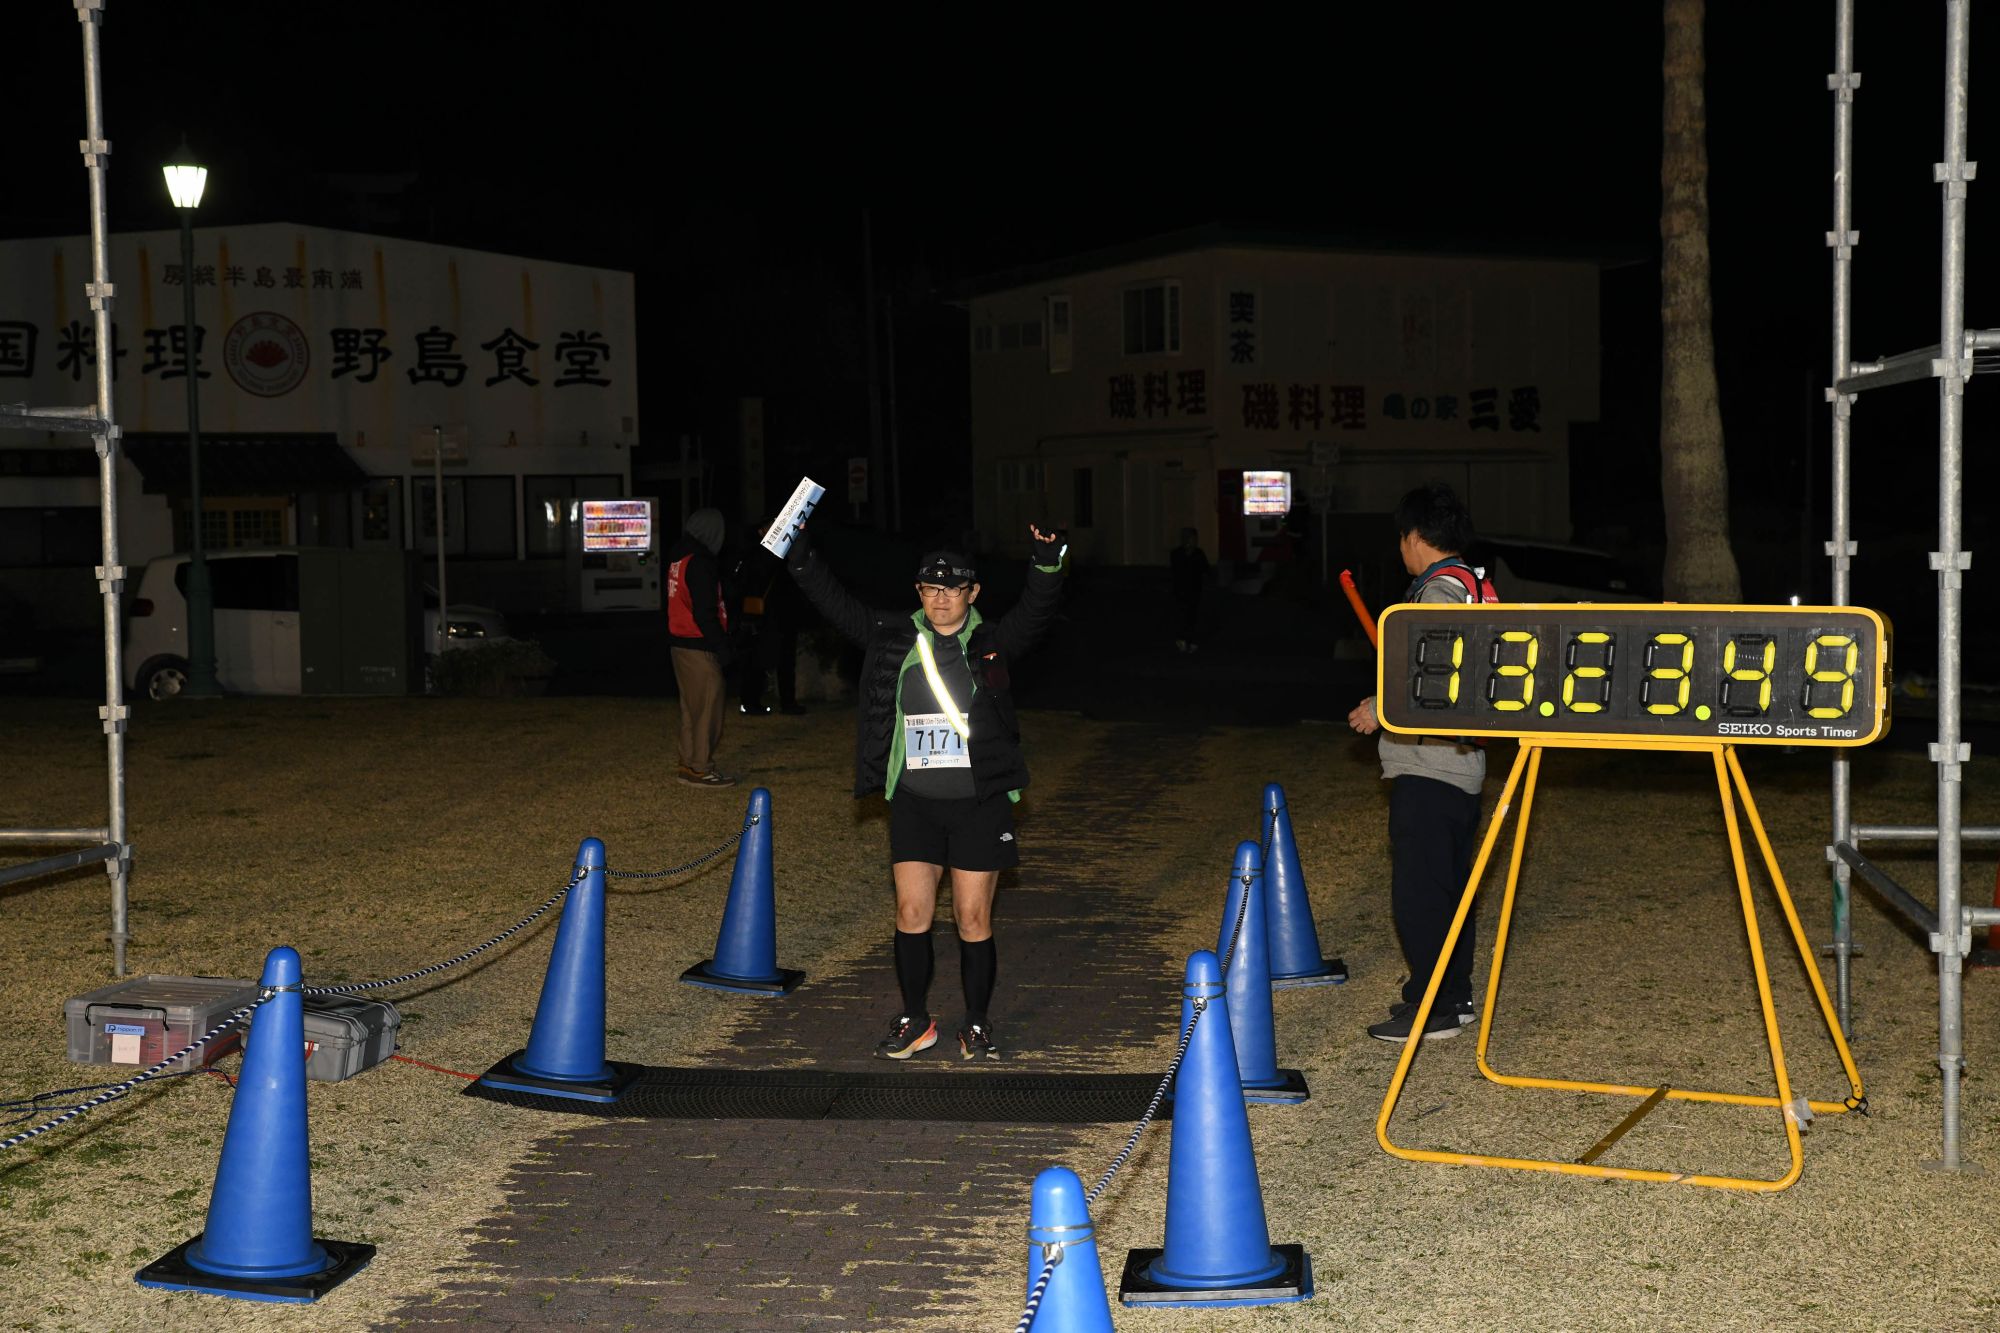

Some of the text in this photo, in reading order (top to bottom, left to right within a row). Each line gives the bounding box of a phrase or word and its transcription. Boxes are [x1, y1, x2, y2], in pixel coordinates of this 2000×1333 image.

[330, 326, 612, 387] 野島食堂
[1109, 369, 1206, 418] 磯料理
[1242, 384, 1366, 430] 磯料理
[1468, 386, 1541, 432] 三愛
[916, 730, 961, 750] 7171
[1718, 723, 1857, 737] SEIKO Sports Timer
